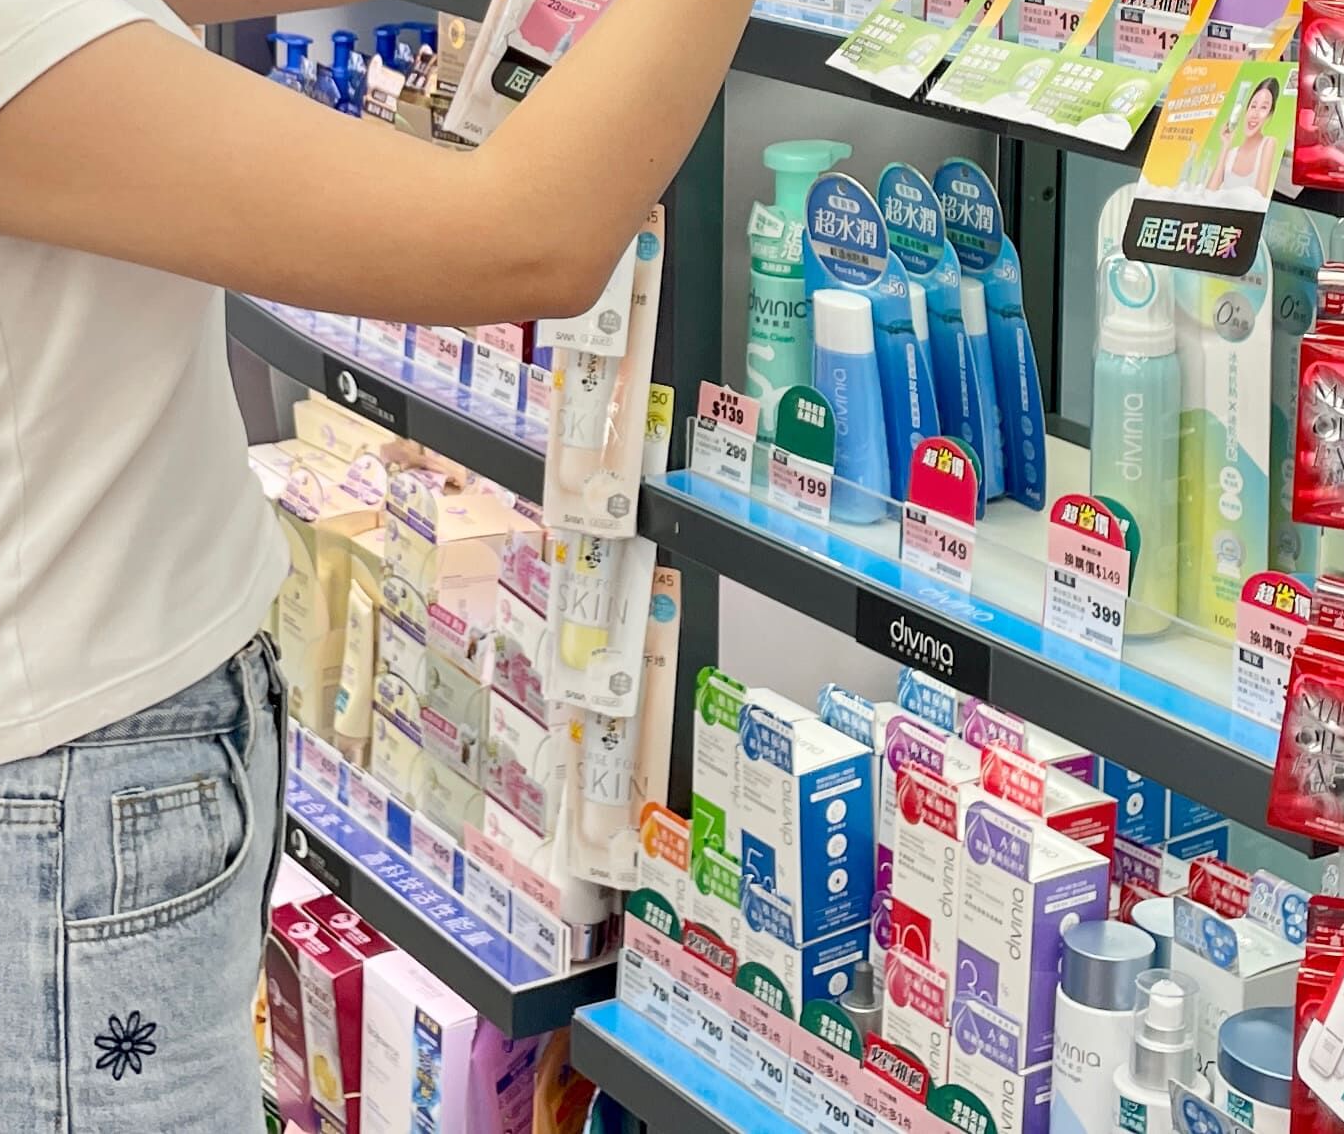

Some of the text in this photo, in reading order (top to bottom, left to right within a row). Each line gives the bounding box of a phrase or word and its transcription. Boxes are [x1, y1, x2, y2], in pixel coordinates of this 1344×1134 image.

[813, 211, 878, 251] 超水潤
[885, 199, 938, 238] 超水潤
[1137, 216, 1242, 260] 屈臣氏獨家
[712, 401, 744, 427] $139
[1118, 392, 1144, 482] divinia
[921, 446, 966, 482] 超省價
[1060, 503, 1111, 539] 超省價
[1254, 580, 1312, 619] 超省價
[889, 616, 955, 667] divinia
[941, 845, 955, 919] divinia
[1006, 887, 1025, 961] divinia
